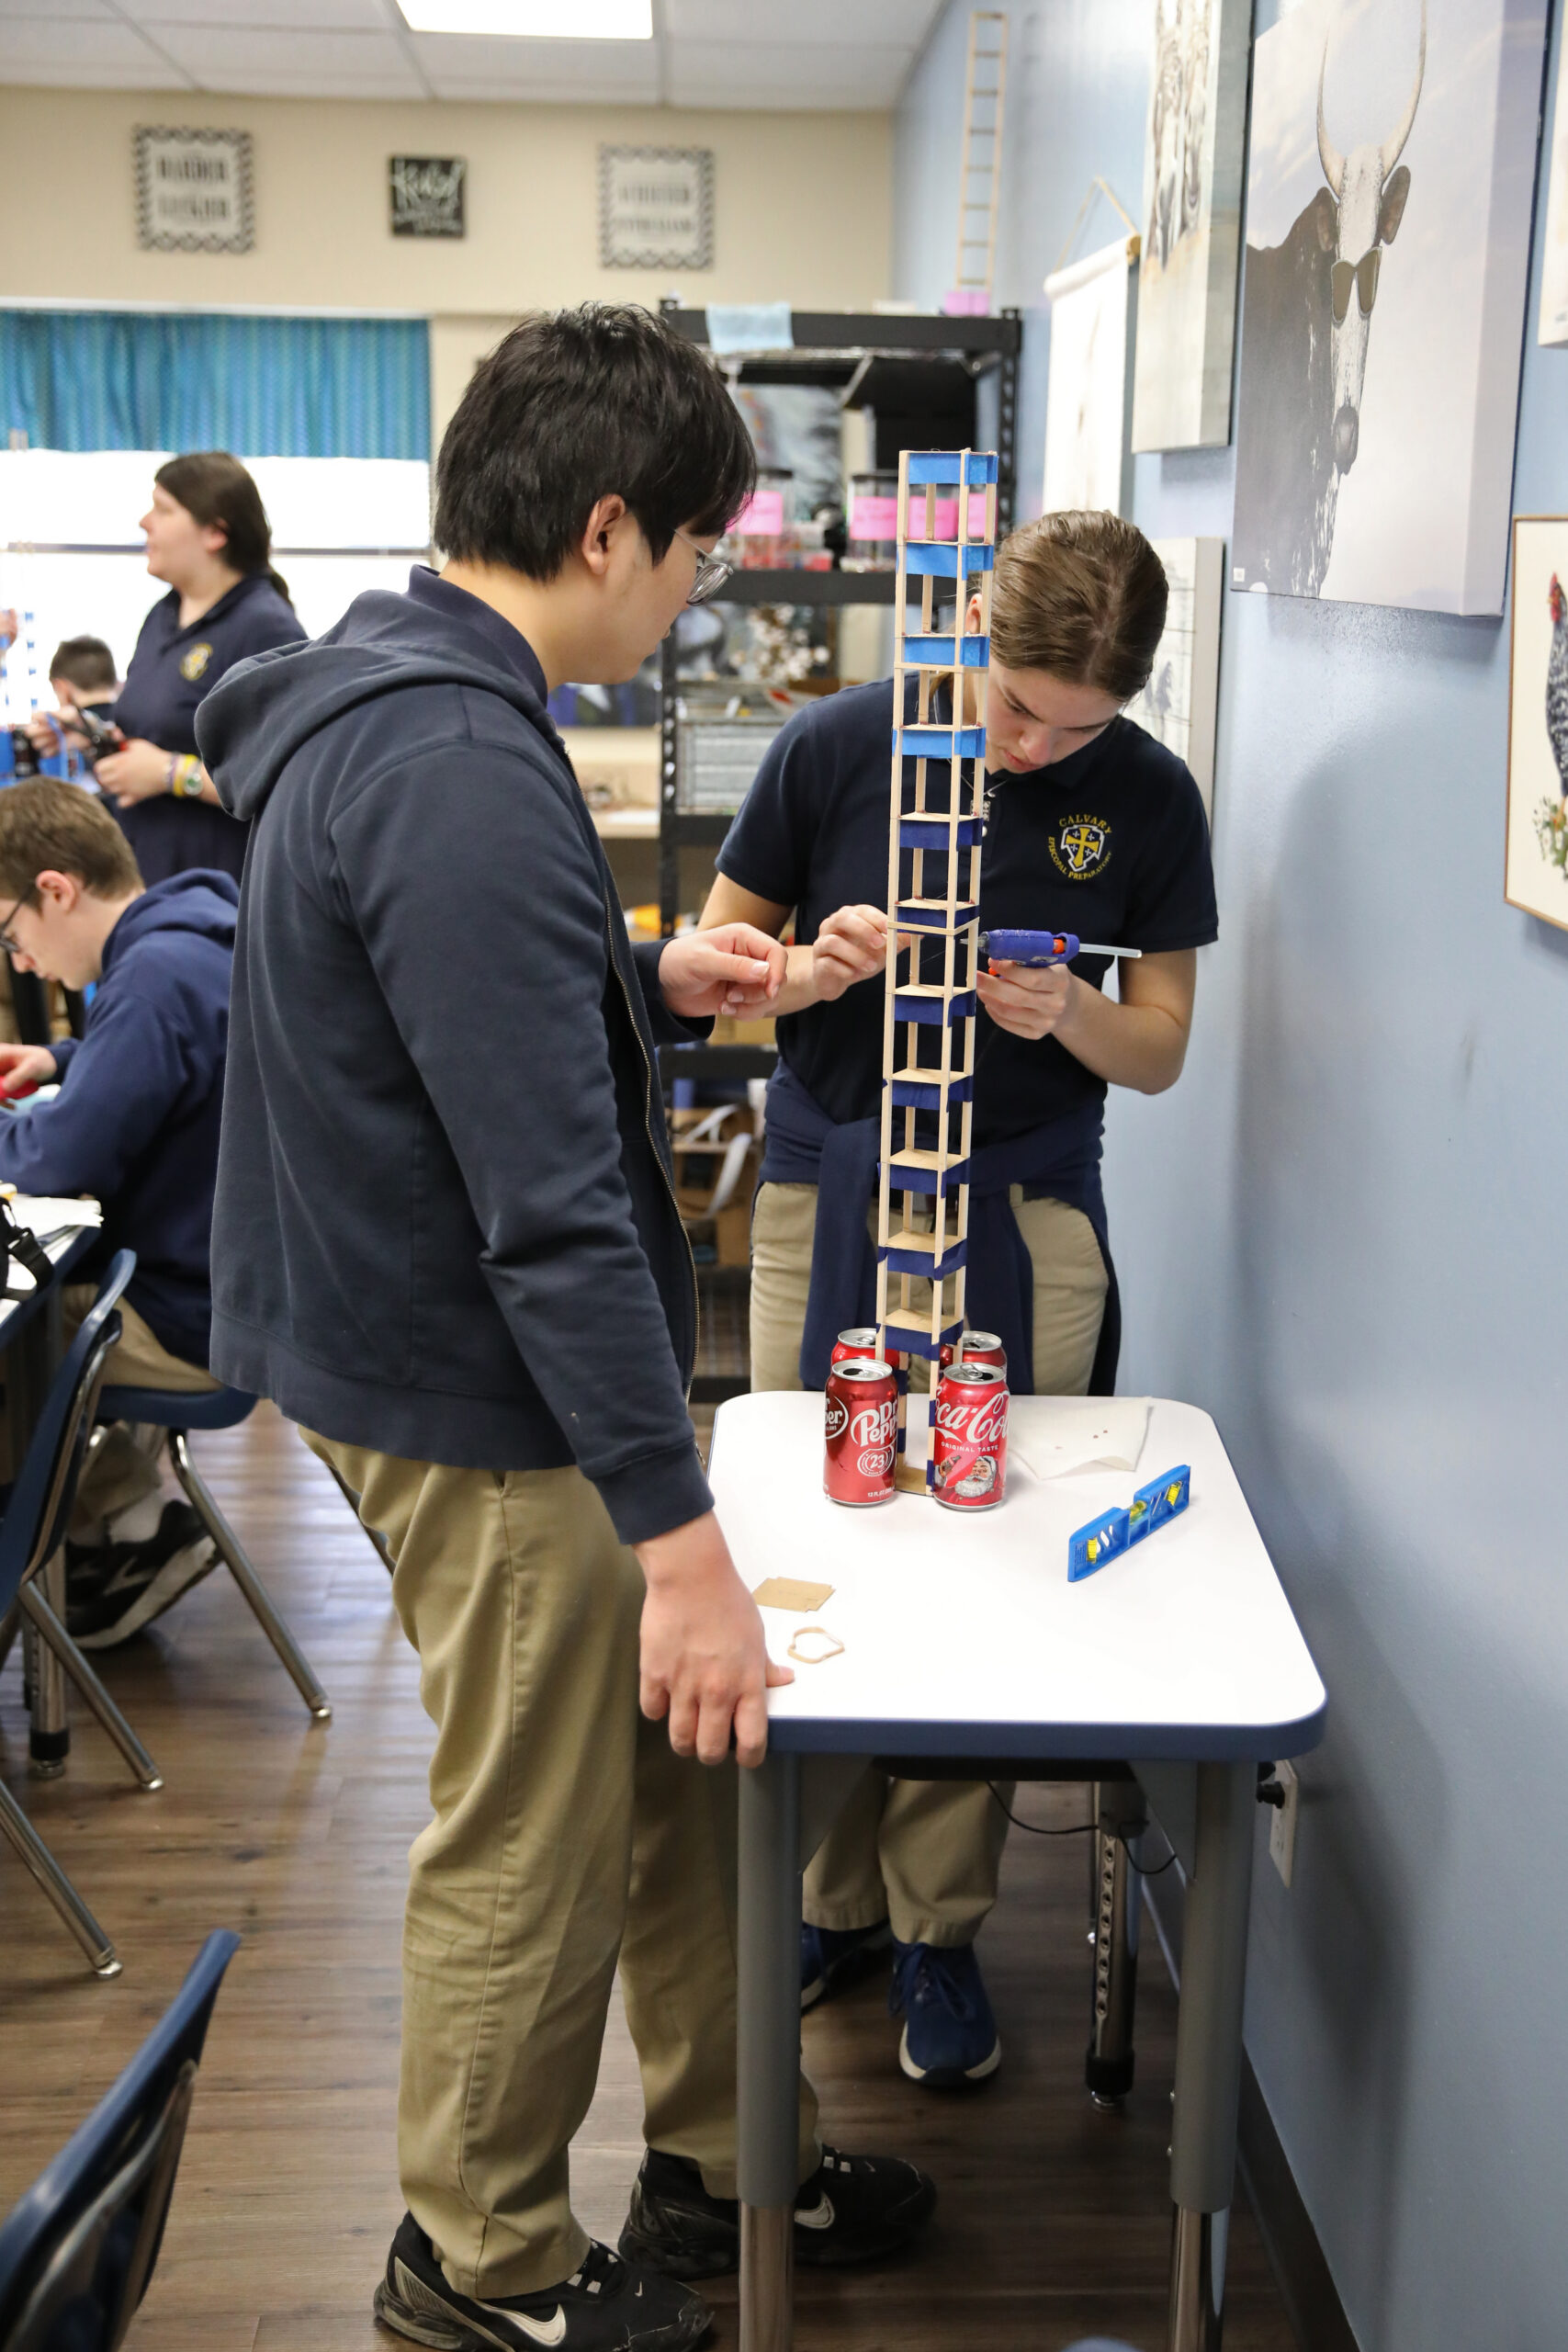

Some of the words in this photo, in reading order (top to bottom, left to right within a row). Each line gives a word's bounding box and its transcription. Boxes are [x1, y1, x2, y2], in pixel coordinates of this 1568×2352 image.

[1059, 814, 1112, 834] CALVARY
[941, 1441, 975, 1453] ORIGINAL
[870, 1454, 885, 1469] 23
